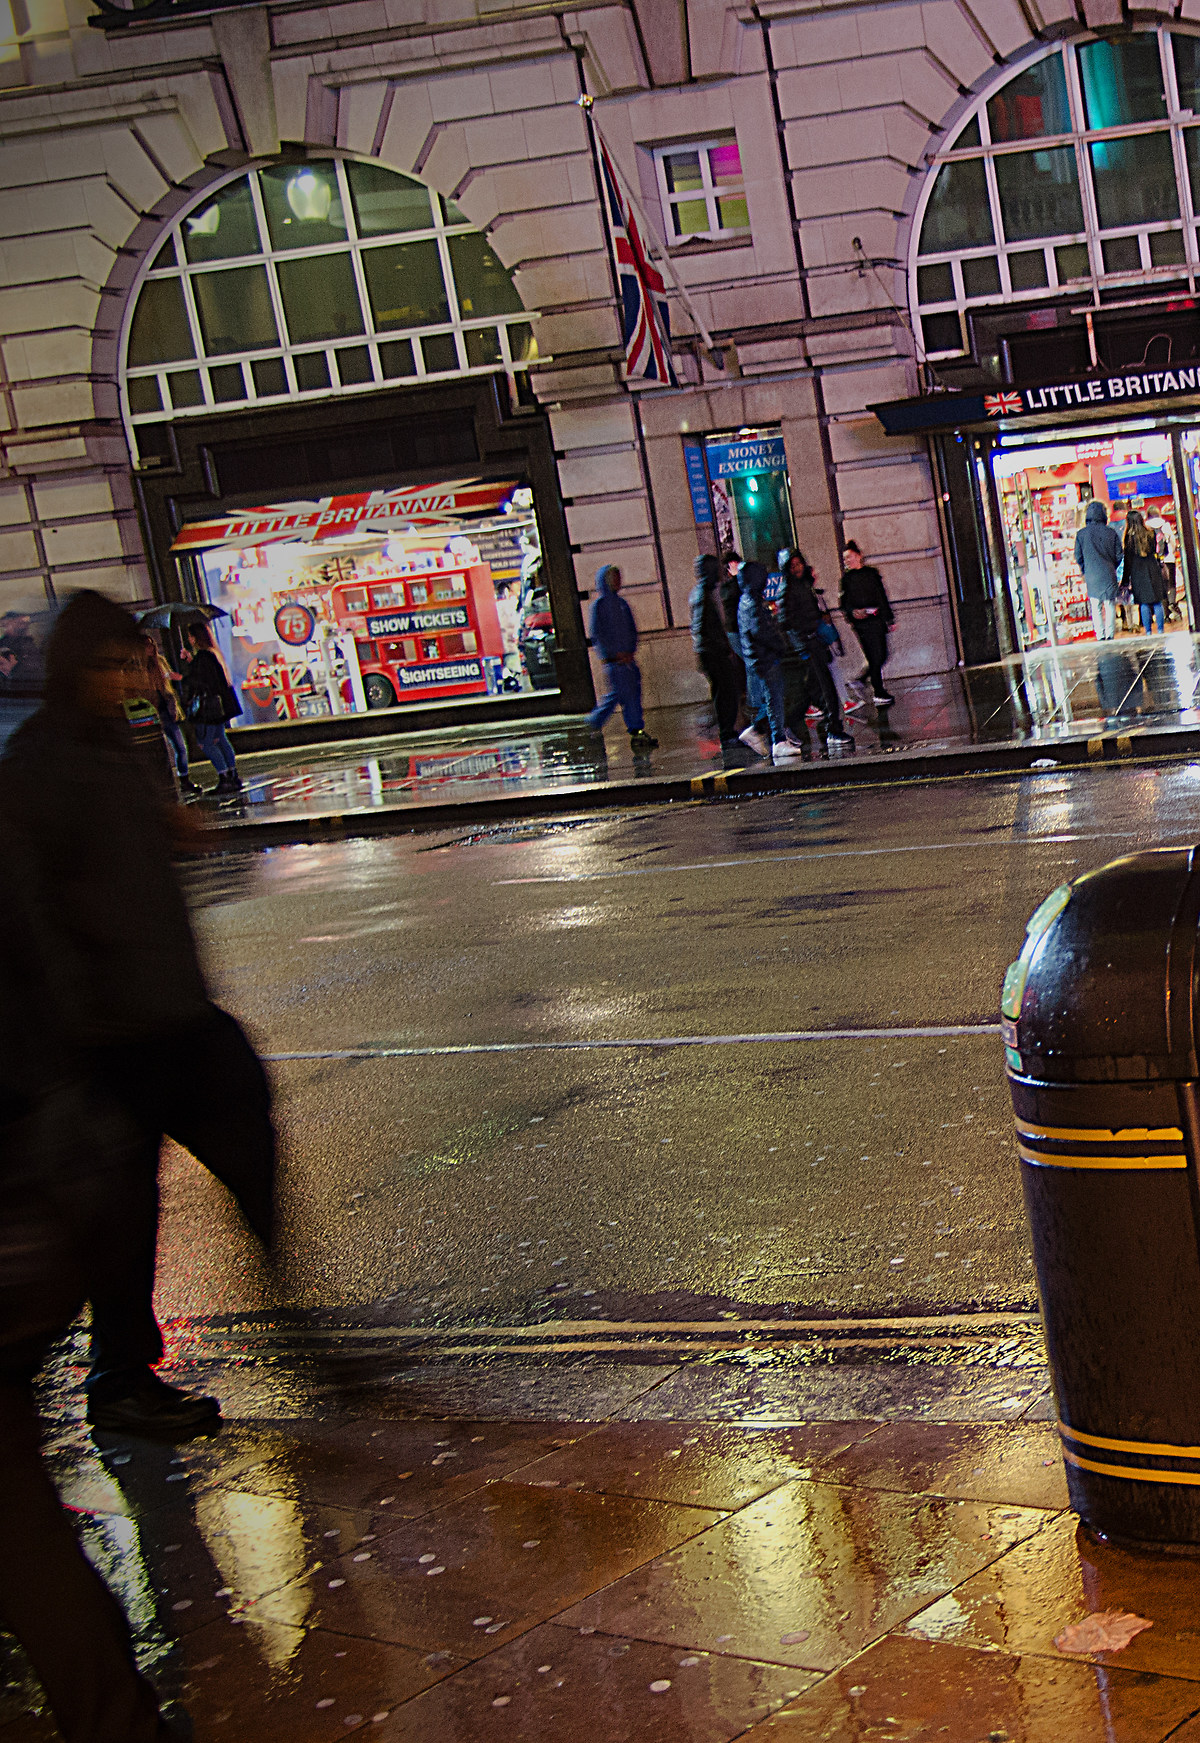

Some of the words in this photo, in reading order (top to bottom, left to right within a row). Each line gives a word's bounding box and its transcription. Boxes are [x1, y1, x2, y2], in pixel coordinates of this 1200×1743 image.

[1026, 381, 1104, 408] LITTLE
[728, 443, 775, 459] MONEY
[223, 516, 310, 538] LITTLE
[316, 495, 456, 527] BRITANNIA
[281, 614, 305, 635] 75
[370, 617, 409, 634] SHOW
[411, 610, 466, 629] TICKETS
[400, 663, 480, 684] SIGHTSEEING
